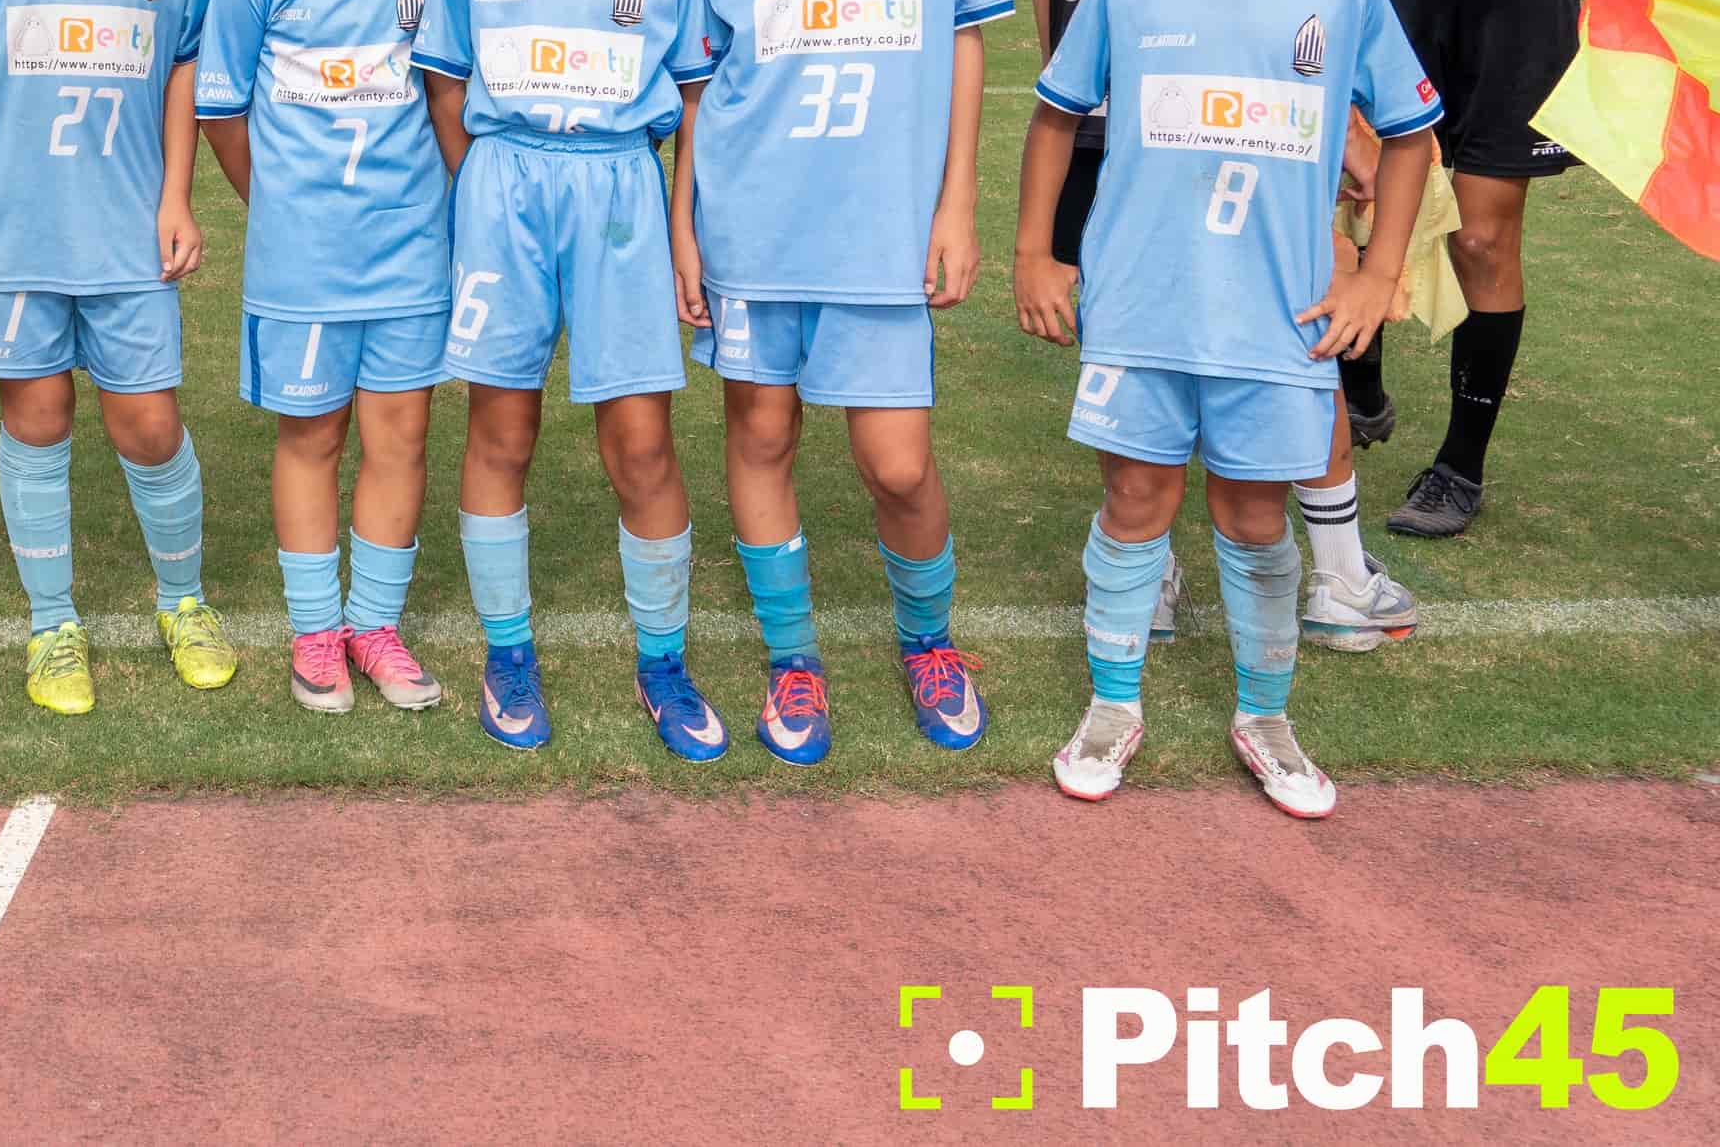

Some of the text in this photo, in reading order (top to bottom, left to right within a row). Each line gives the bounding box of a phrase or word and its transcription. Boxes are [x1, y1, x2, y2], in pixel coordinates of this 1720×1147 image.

[531, 38, 635, 82] Renty
[49, 86, 124, 156] 27
[789, 63, 876, 138] 33
[1201, 90, 1318, 135] Renty
[332, 118, 368, 186] 7
[1205, 160, 1258, 235] 8
